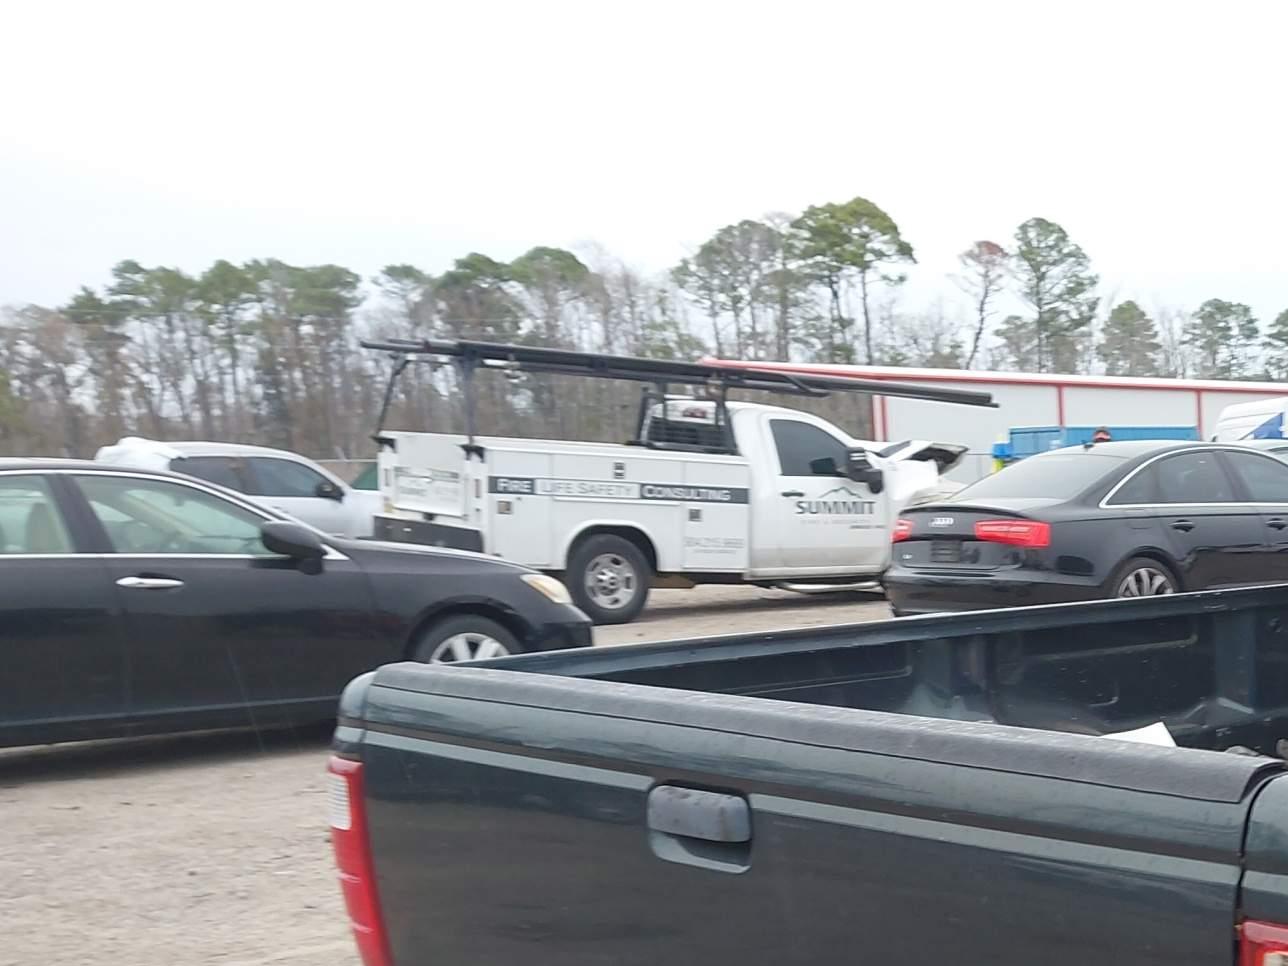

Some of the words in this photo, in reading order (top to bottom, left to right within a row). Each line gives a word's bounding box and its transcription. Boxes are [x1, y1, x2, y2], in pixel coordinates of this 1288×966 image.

[496, 478, 533, 494] FIRE
[541, 480, 573, 494] LIFE
[577, 482, 633, 497] SAFETY
[642, 485, 731, 501] CONSULTING
[795, 500, 876, 515] SUMMIT
